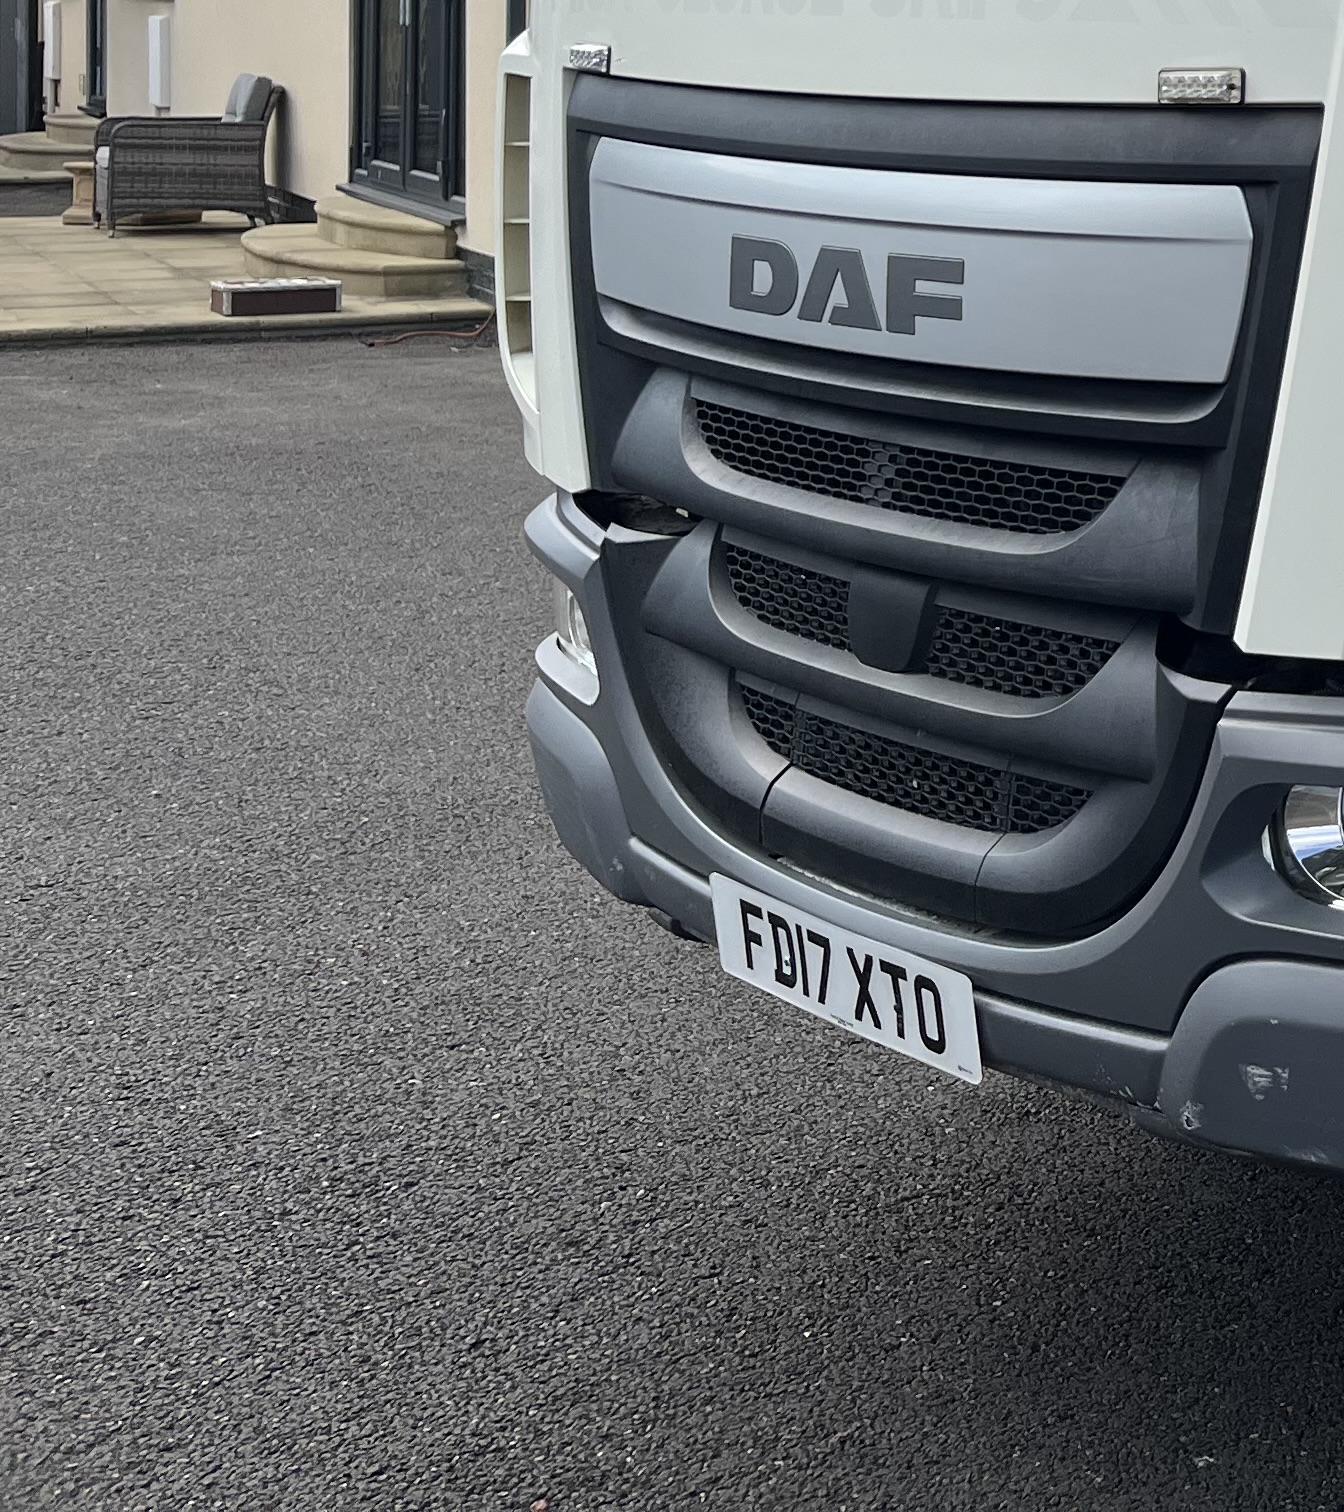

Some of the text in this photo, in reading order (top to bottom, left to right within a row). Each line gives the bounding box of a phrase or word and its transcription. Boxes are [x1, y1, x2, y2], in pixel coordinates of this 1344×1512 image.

[729, 233, 965, 335] DAF
[739, 898, 947, 1055] FD17 XTO
